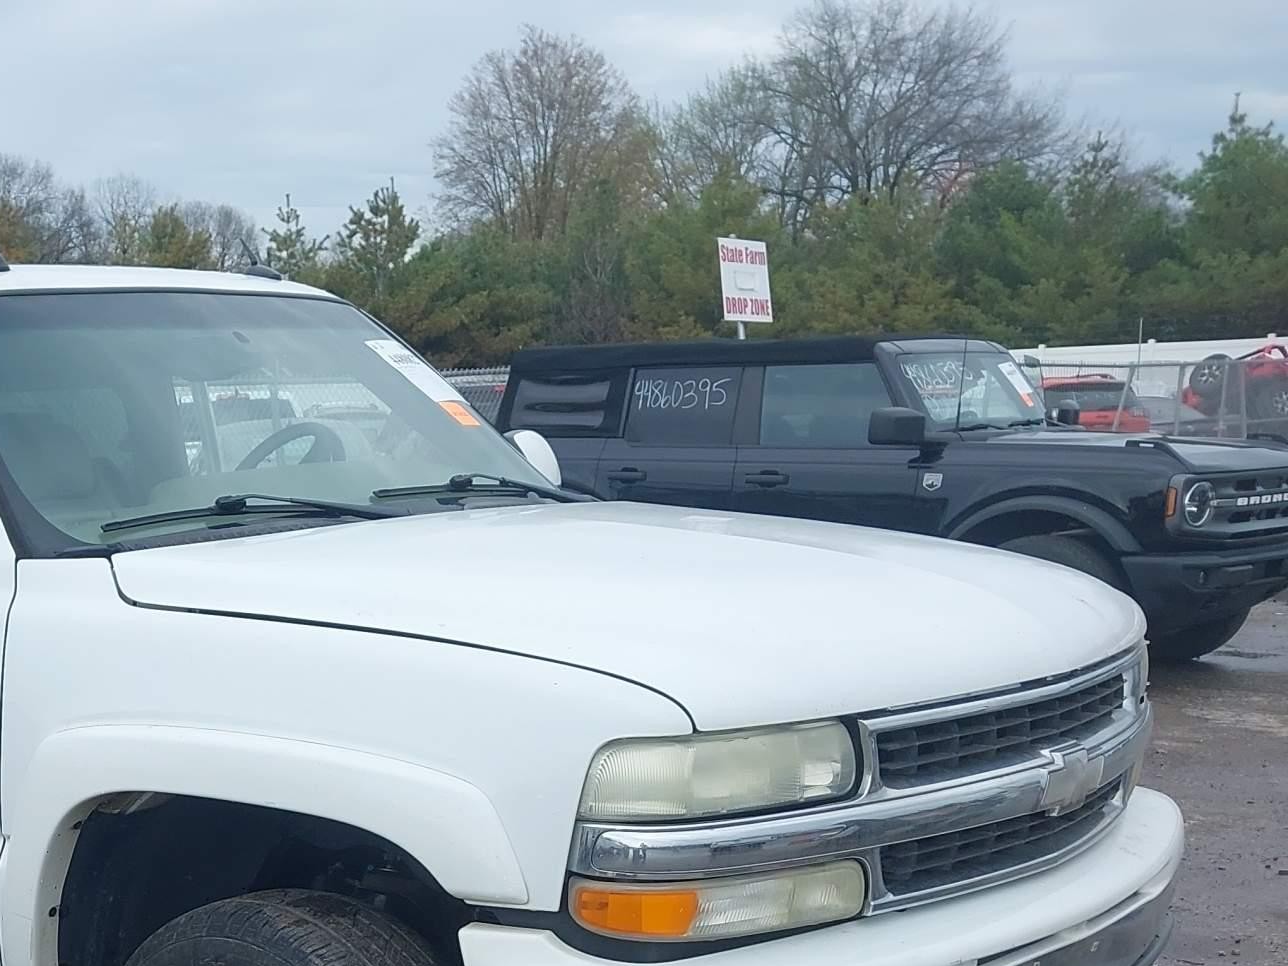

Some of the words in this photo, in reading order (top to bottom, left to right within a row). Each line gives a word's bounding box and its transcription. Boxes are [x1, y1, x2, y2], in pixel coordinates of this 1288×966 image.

[720, 244, 744, 264] State
[744, 246, 767, 266] Farm
[724, 296, 748, 315] DROP
[749, 298, 771, 317] ZONE
[634, 377, 733, 410] 44860395
